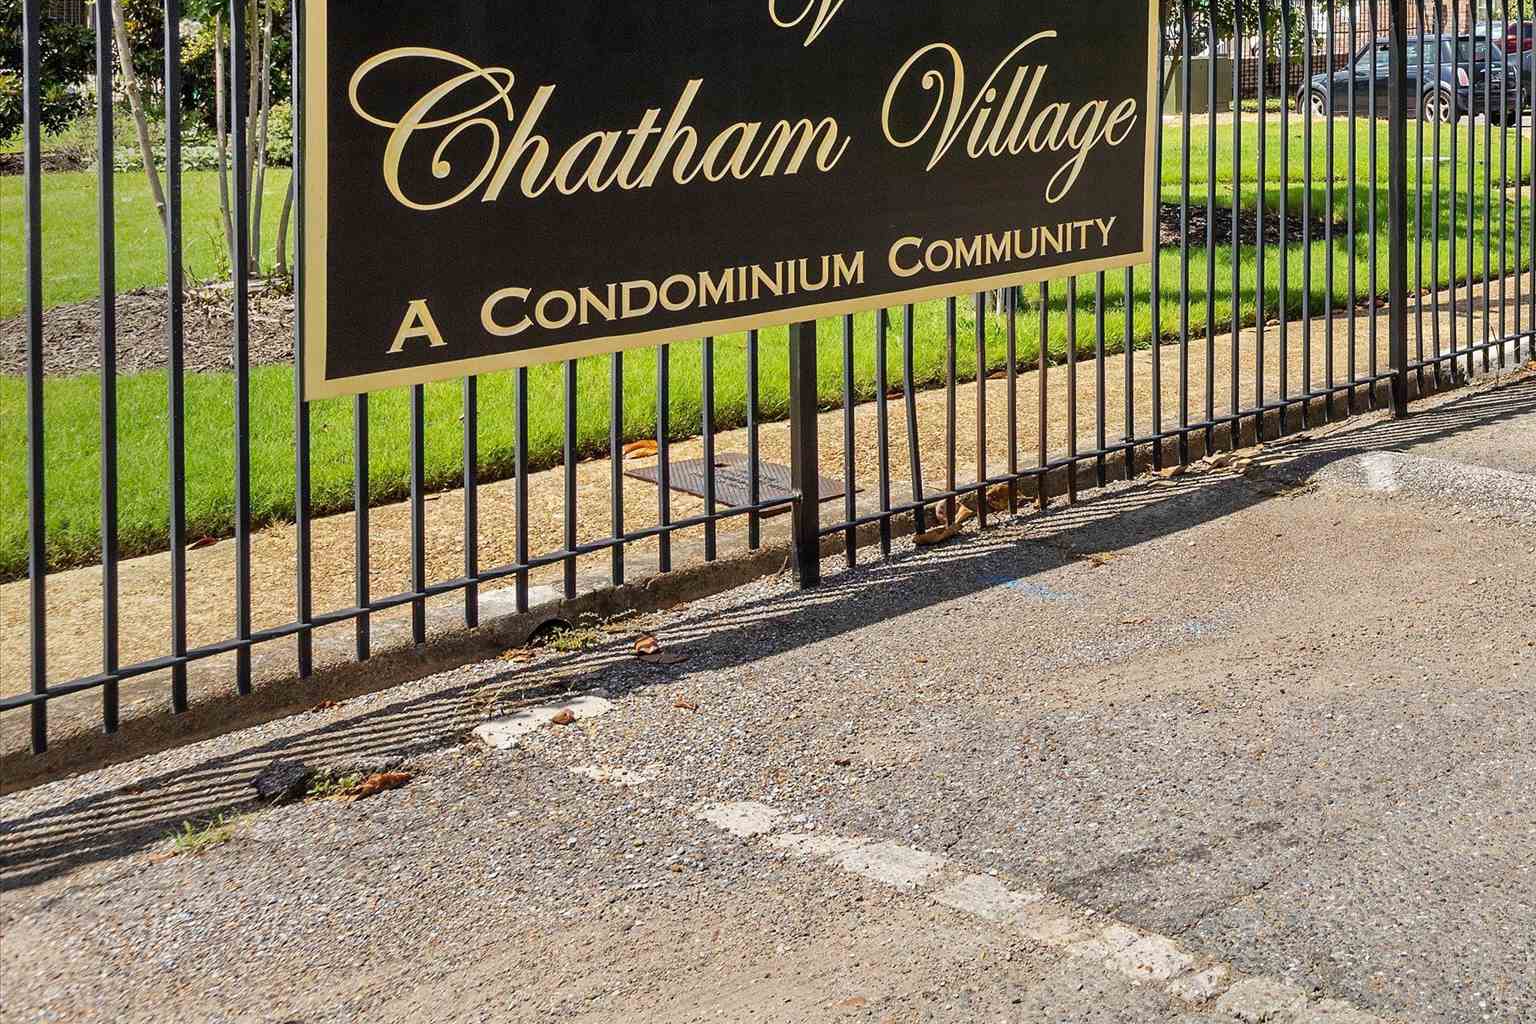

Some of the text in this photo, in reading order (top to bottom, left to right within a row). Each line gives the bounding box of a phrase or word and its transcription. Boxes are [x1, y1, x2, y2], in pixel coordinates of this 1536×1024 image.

[348, 29, 1138, 211] Chatham Village
[385, 215, 1117, 354] A CONDOMINIUM COMMUNITY
